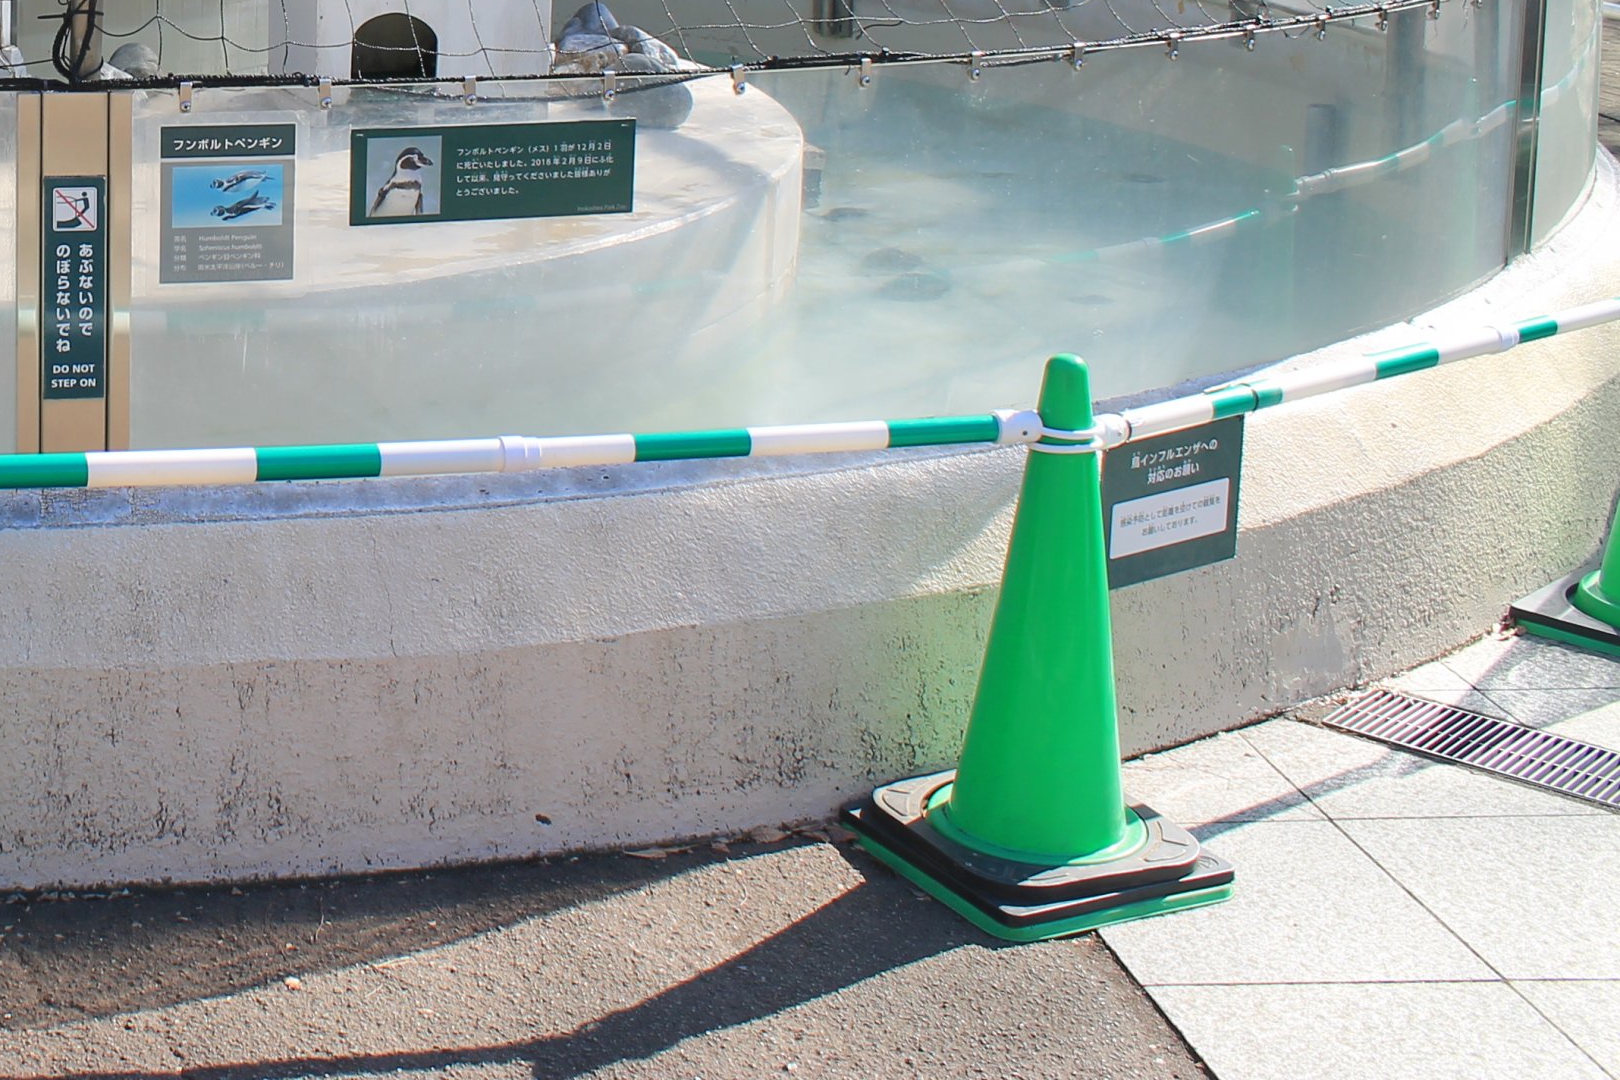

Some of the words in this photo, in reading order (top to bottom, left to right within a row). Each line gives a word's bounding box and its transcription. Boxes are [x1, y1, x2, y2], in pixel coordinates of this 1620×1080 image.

[173, 137, 283, 151] フンボルトペンギン
[456, 187, 520, 197] とうございました。
[79, 243, 93, 336] あぶないので
[56, 244, 71, 353] のぼらないでね
[52, 365, 70, 374] DO
[72, 364, 95, 373] NOT
[51, 378, 77, 388] STEP
[79, 378, 96, 387] ON
[1131, 439, 1218, 469] 鳥インフルエンザへの
